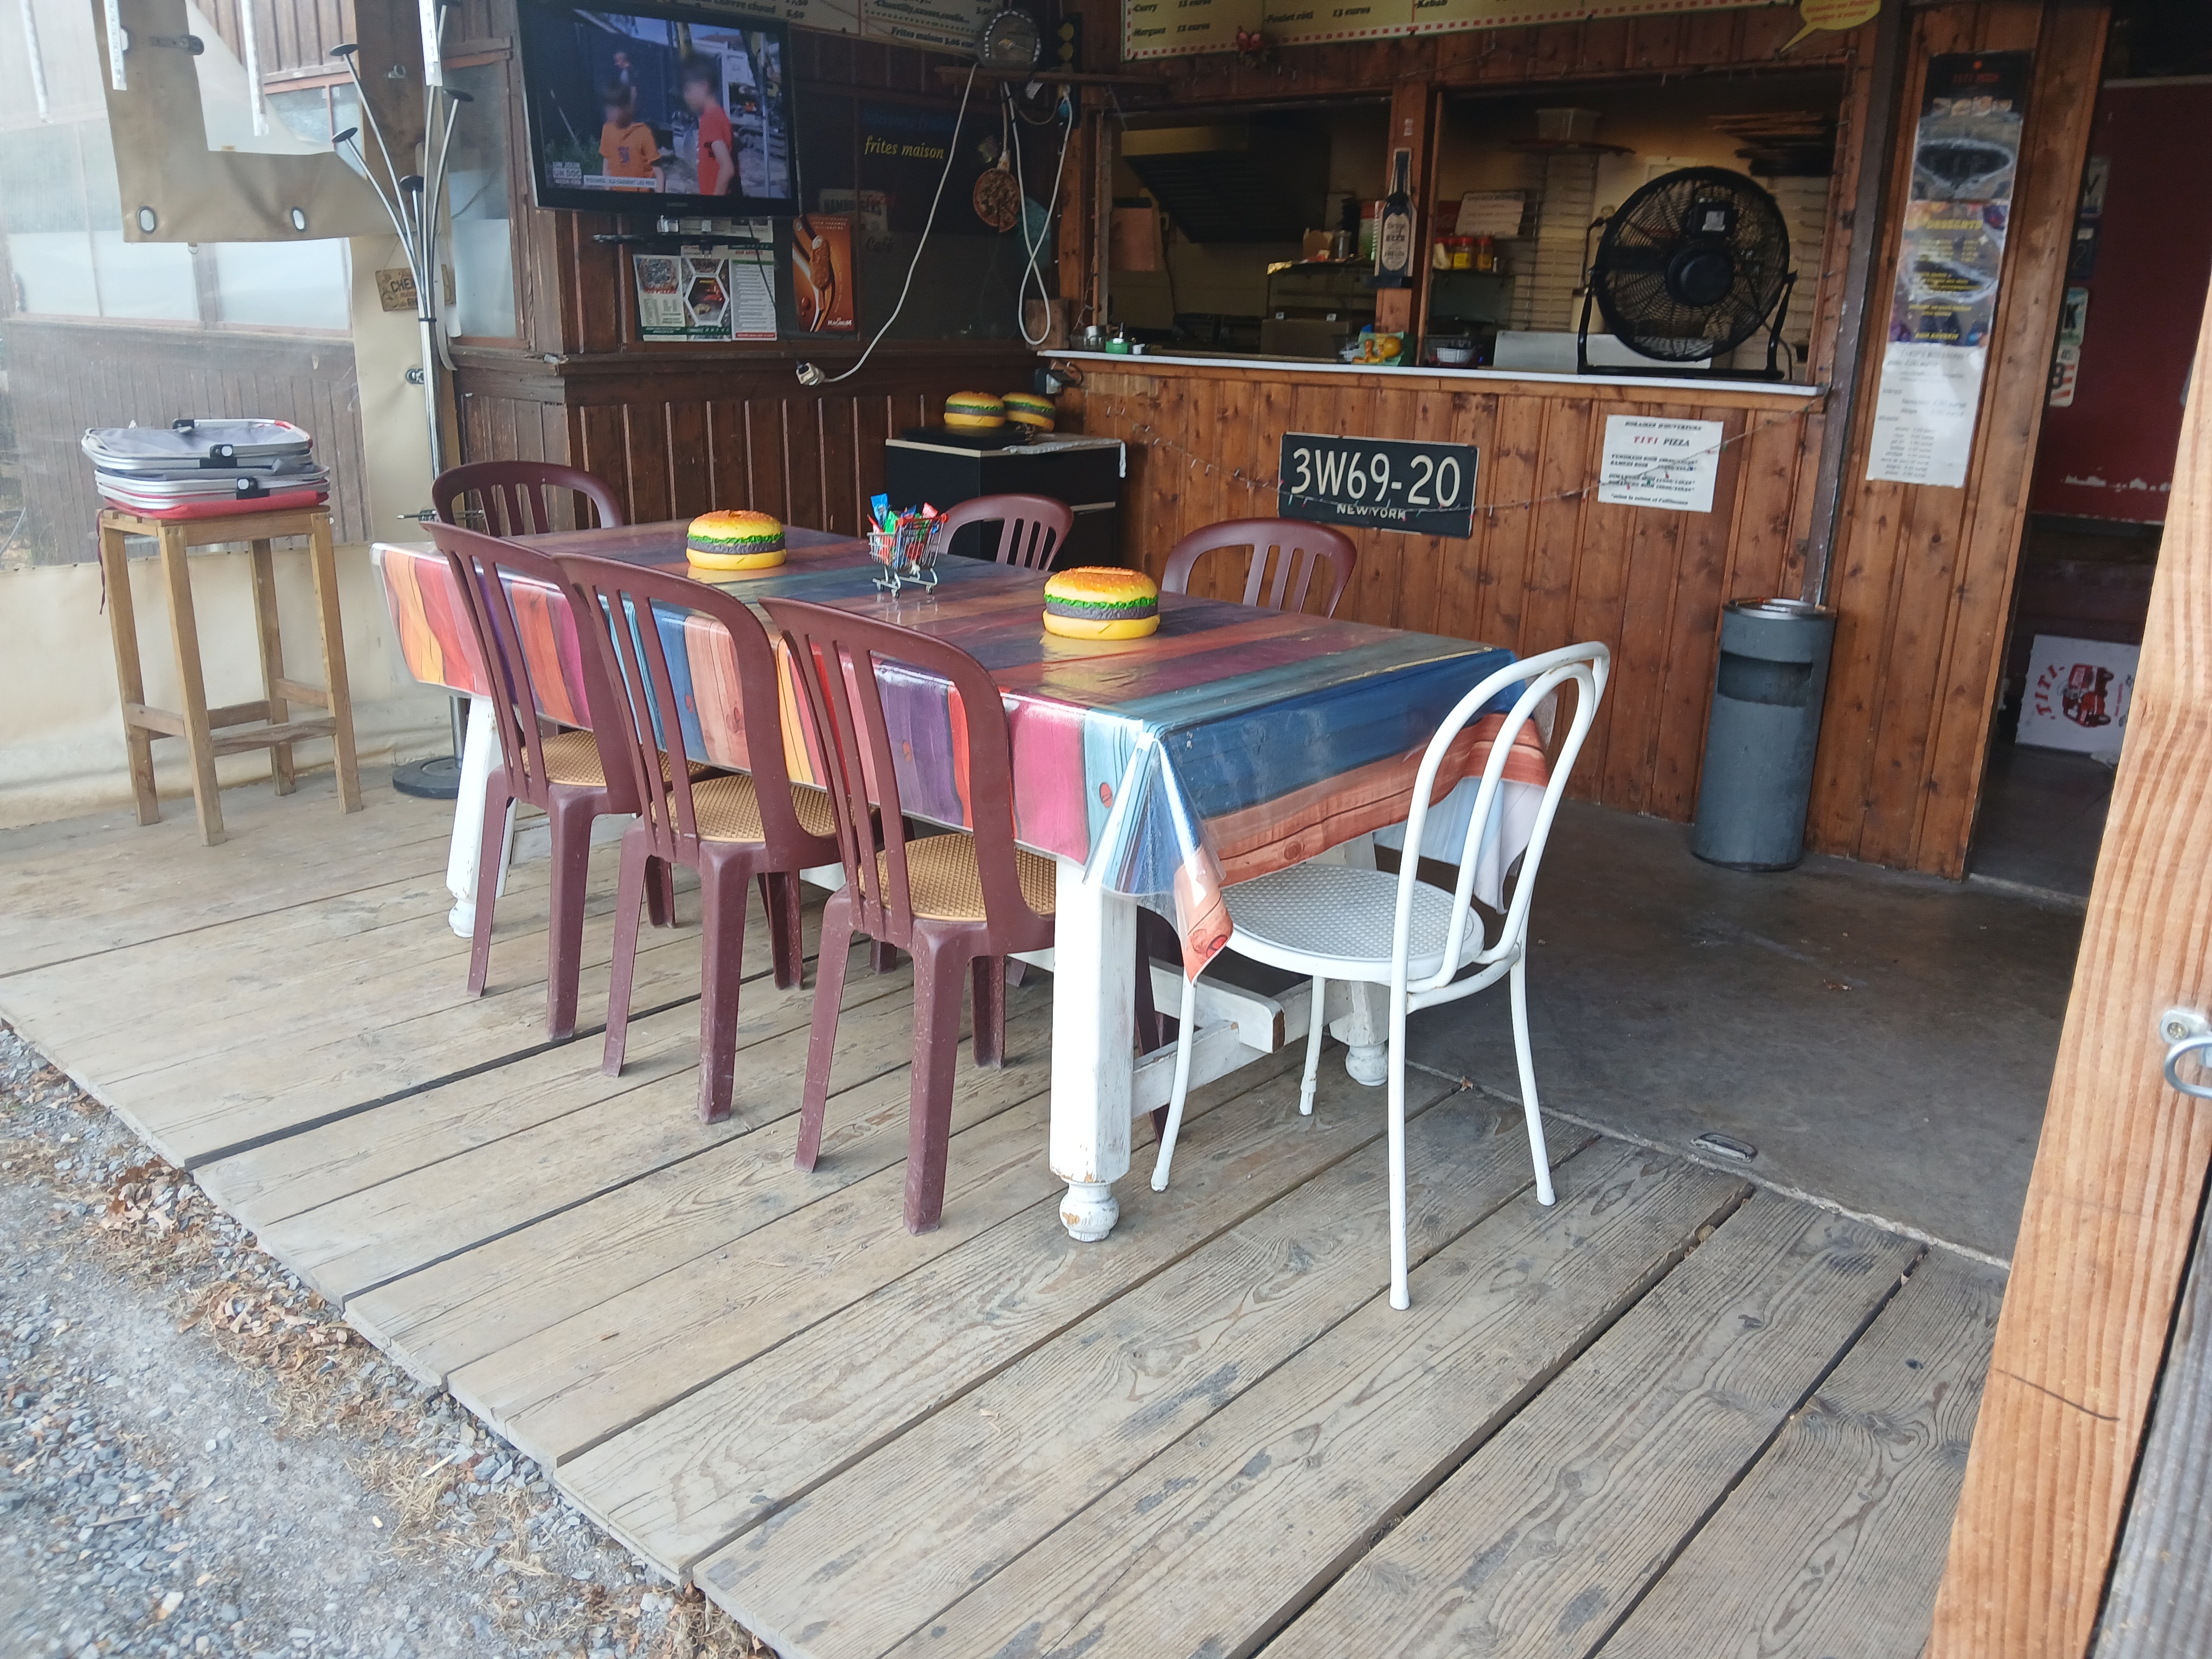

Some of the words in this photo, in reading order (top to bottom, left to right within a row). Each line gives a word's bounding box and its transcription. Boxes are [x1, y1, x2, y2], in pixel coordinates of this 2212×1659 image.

[864, 135, 898, 155] frites
[901, 142, 944, 159] maison
[1663, 438, 1690, 447] PIZZA
[1291, 448, 1461, 507] 3W69-20
[1337, 503, 1368, 516] NEW
[1369, 507, 1405, 519] YORK
